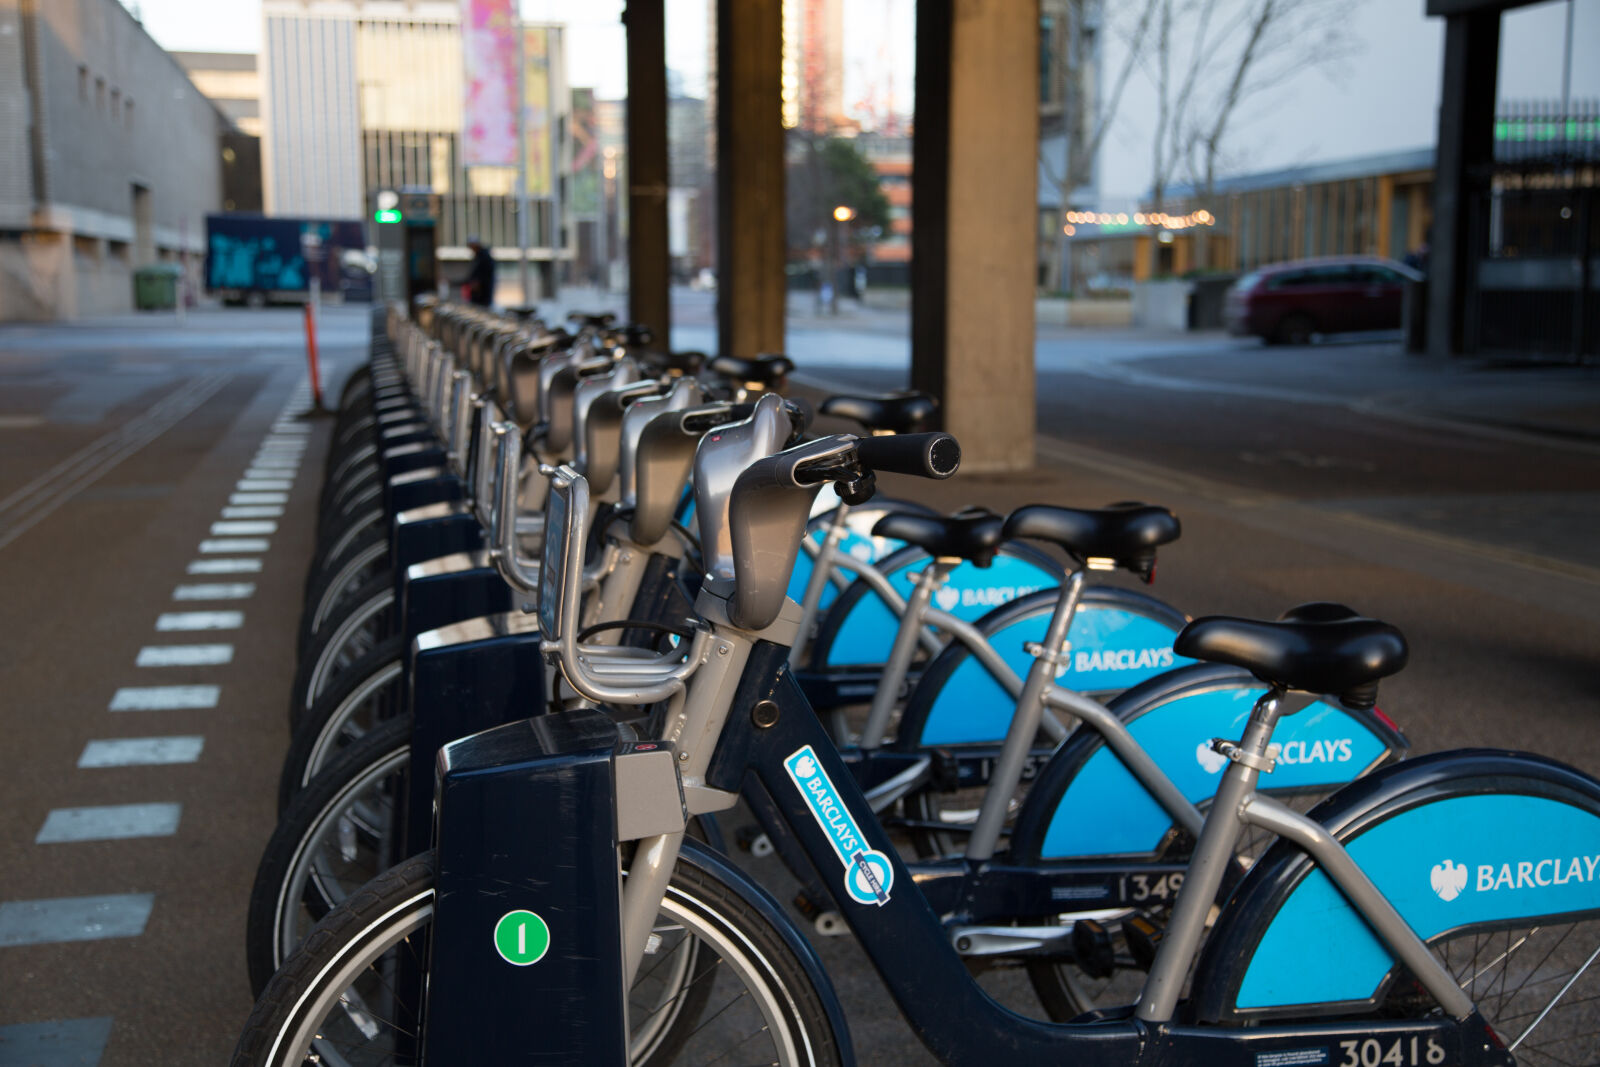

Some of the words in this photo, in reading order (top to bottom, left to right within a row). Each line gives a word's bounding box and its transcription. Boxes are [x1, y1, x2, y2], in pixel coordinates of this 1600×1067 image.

[1075, 646, 1174, 672] BARCLAYS
[1267, 739, 1353, 765] RCLAYS
[806, 776, 858, 851] BARCLAYS
[859, 860, 874, 881] CYCLE
[1476, 855, 1600, 892] BARCLAY
[1119, 872, 1184, 902] 1349
[518, 922, 526, 954] 1
